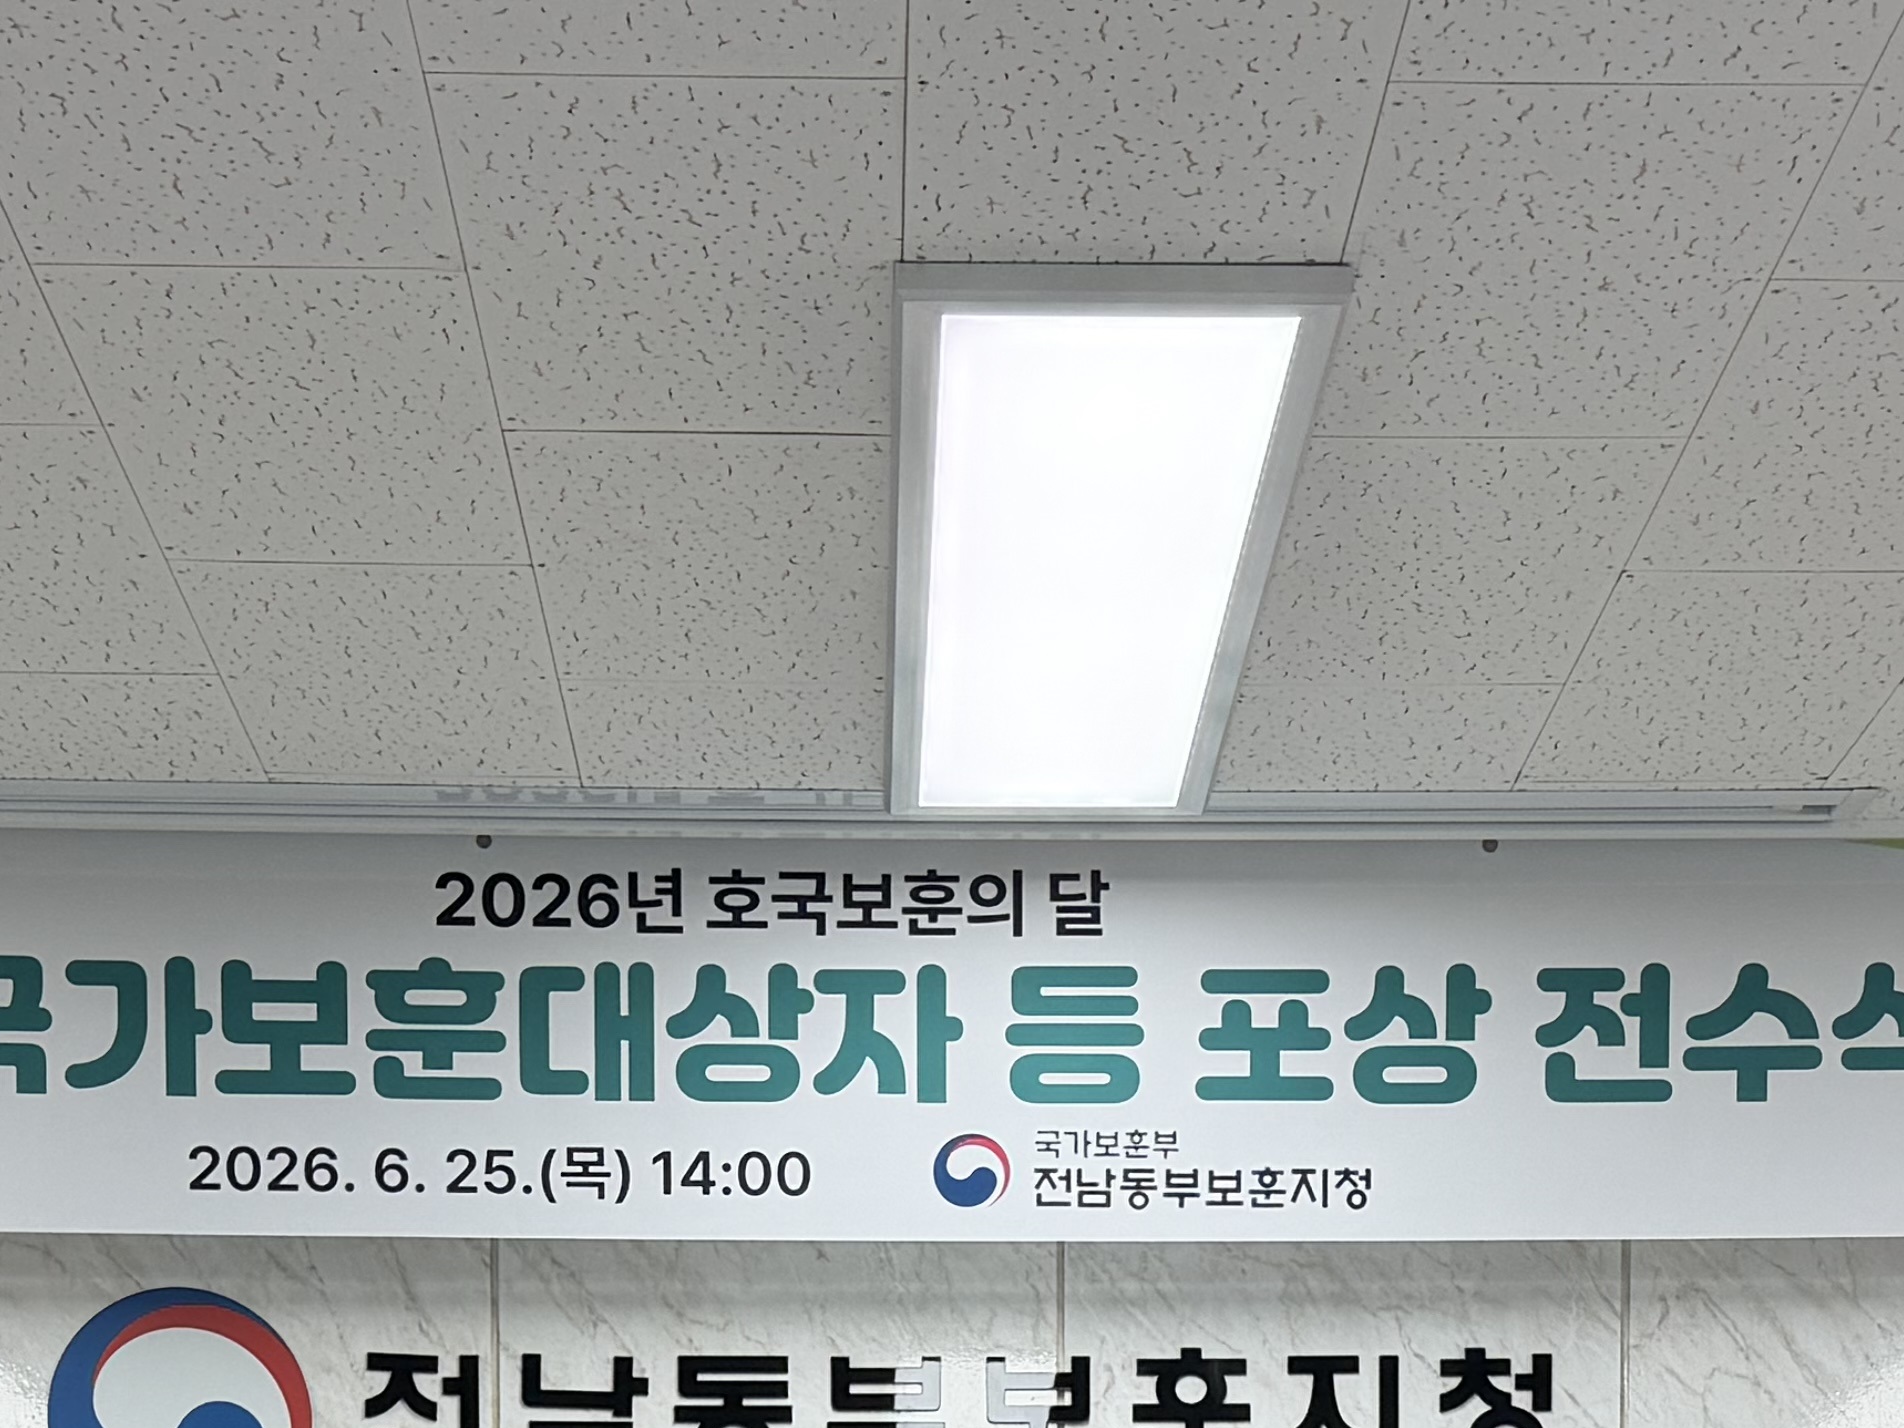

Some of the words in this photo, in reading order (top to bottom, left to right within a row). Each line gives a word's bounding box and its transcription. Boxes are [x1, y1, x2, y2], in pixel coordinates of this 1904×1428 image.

[435, 867, 684, 934] 2026년
[706, 867, 1024, 938] 호국보훈의
[1048, 868, 1111, 937] 달
[1005, 966, 1144, 1104] 등
[1195, 963, 1493, 1104] 포상
[1034, 1129, 1179, 1160] 국가보훈부
[188, 1145, 355, 1193] 2026.
[374, 1147, 425, 1194] 6.
[446, 1146, 631, 1205] 25.(목)
[651, 1150, 811, 1197] 14:00
[1033, 1166, 1372, 1211] 전남동부보훈지청
